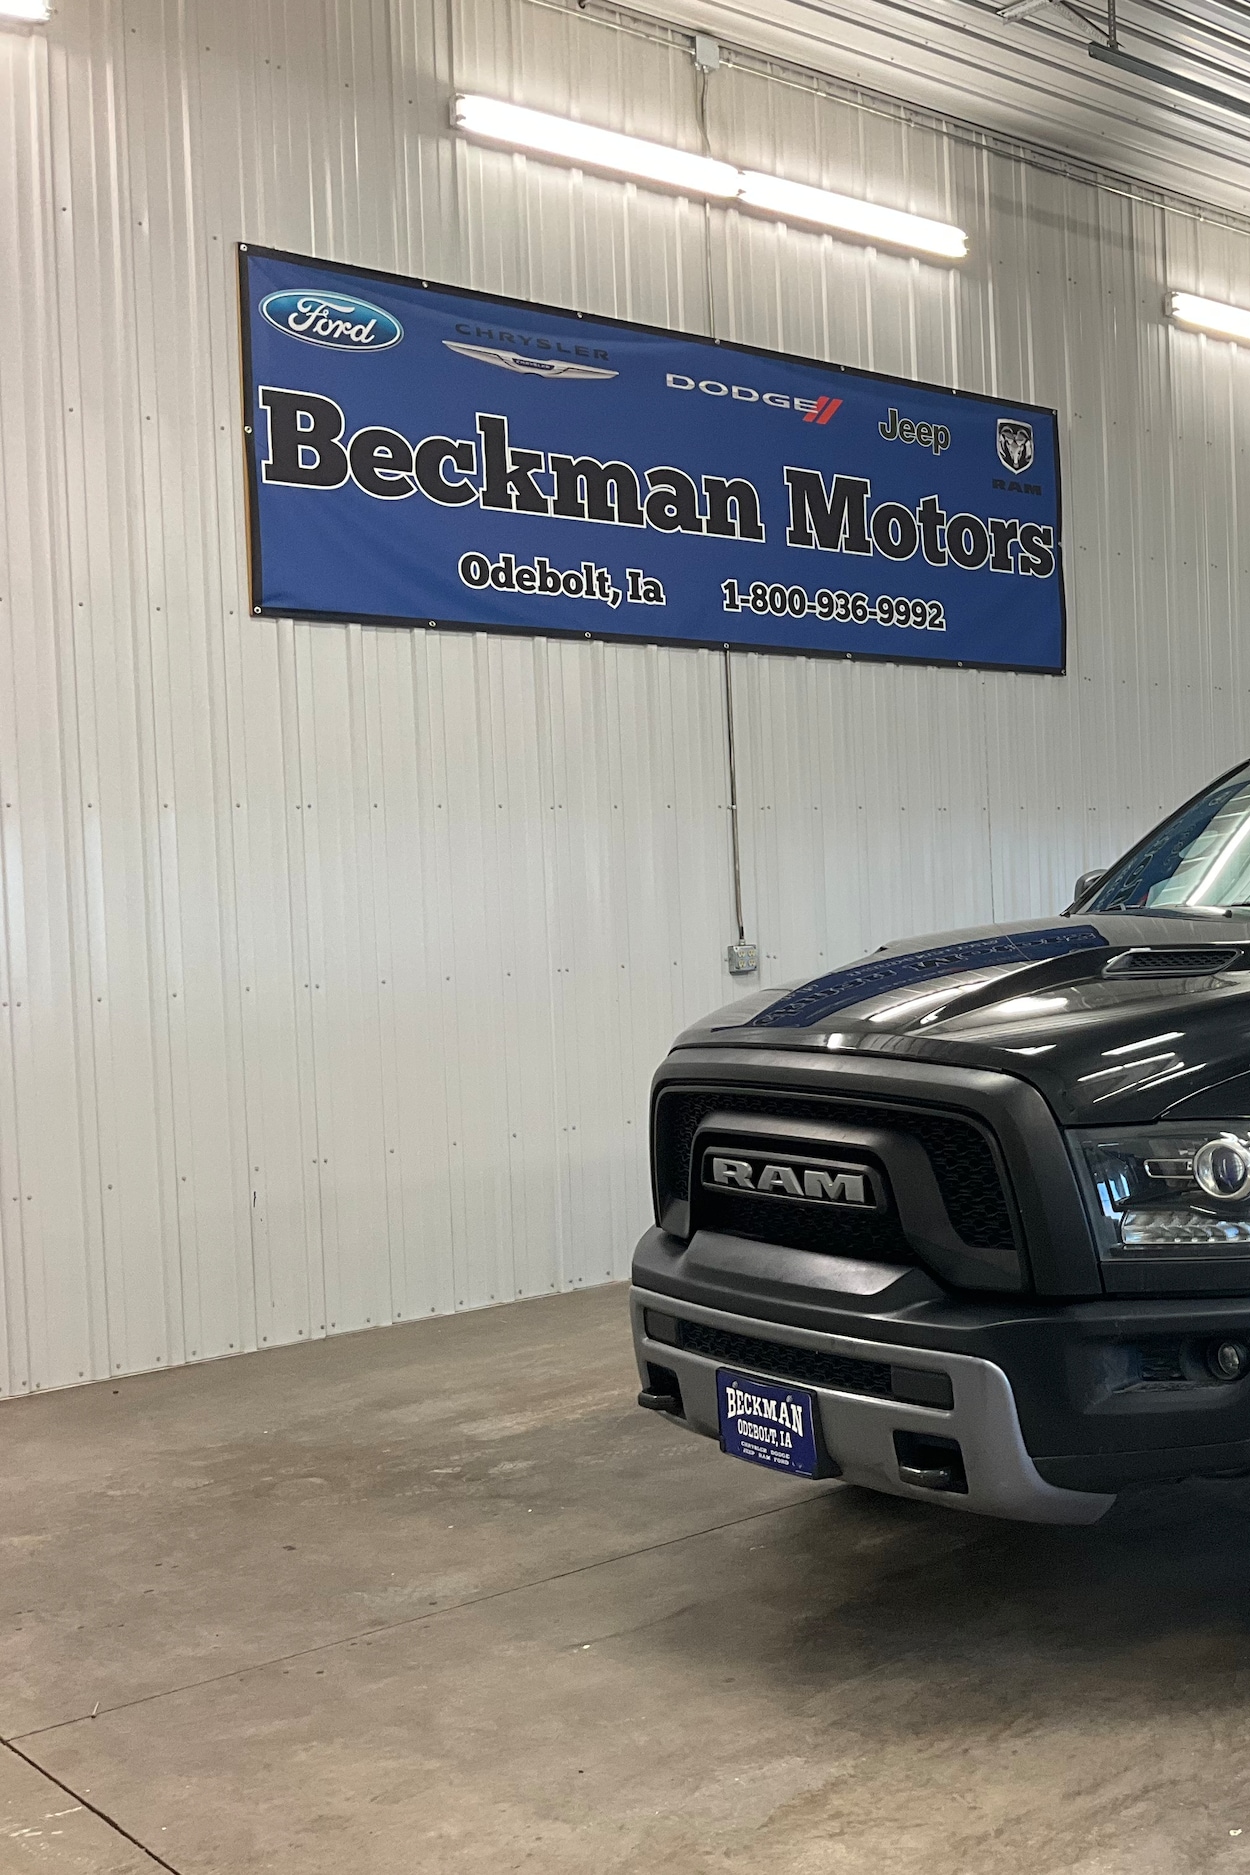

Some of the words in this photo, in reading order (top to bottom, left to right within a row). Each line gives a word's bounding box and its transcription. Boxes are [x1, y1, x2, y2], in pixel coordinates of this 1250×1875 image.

[287, 297, 377, 343] Ford
[454, 322, 610, 361] CHRYSLER
[666, 373, 819, 413] DODGE
[878, 408, 951, 455] Jeep
[258, 385, 766, 543] Beckman
[783, 465, 1056, 578] Motors
[991, 478, 1042, 496] RAM
[457, 551, 623, 609] Odebolt,
[625, 568, 667, 606] Ia
[720, 579, 947, 631] 1-800-936-9992
[712, 1157, 865, 1203] RAM
[726, 1386, 804, 1437] BECKMAN
[737, 1418, 779, 1447] ODEBOLT,
[779, 1430, 793, 1448] IA
